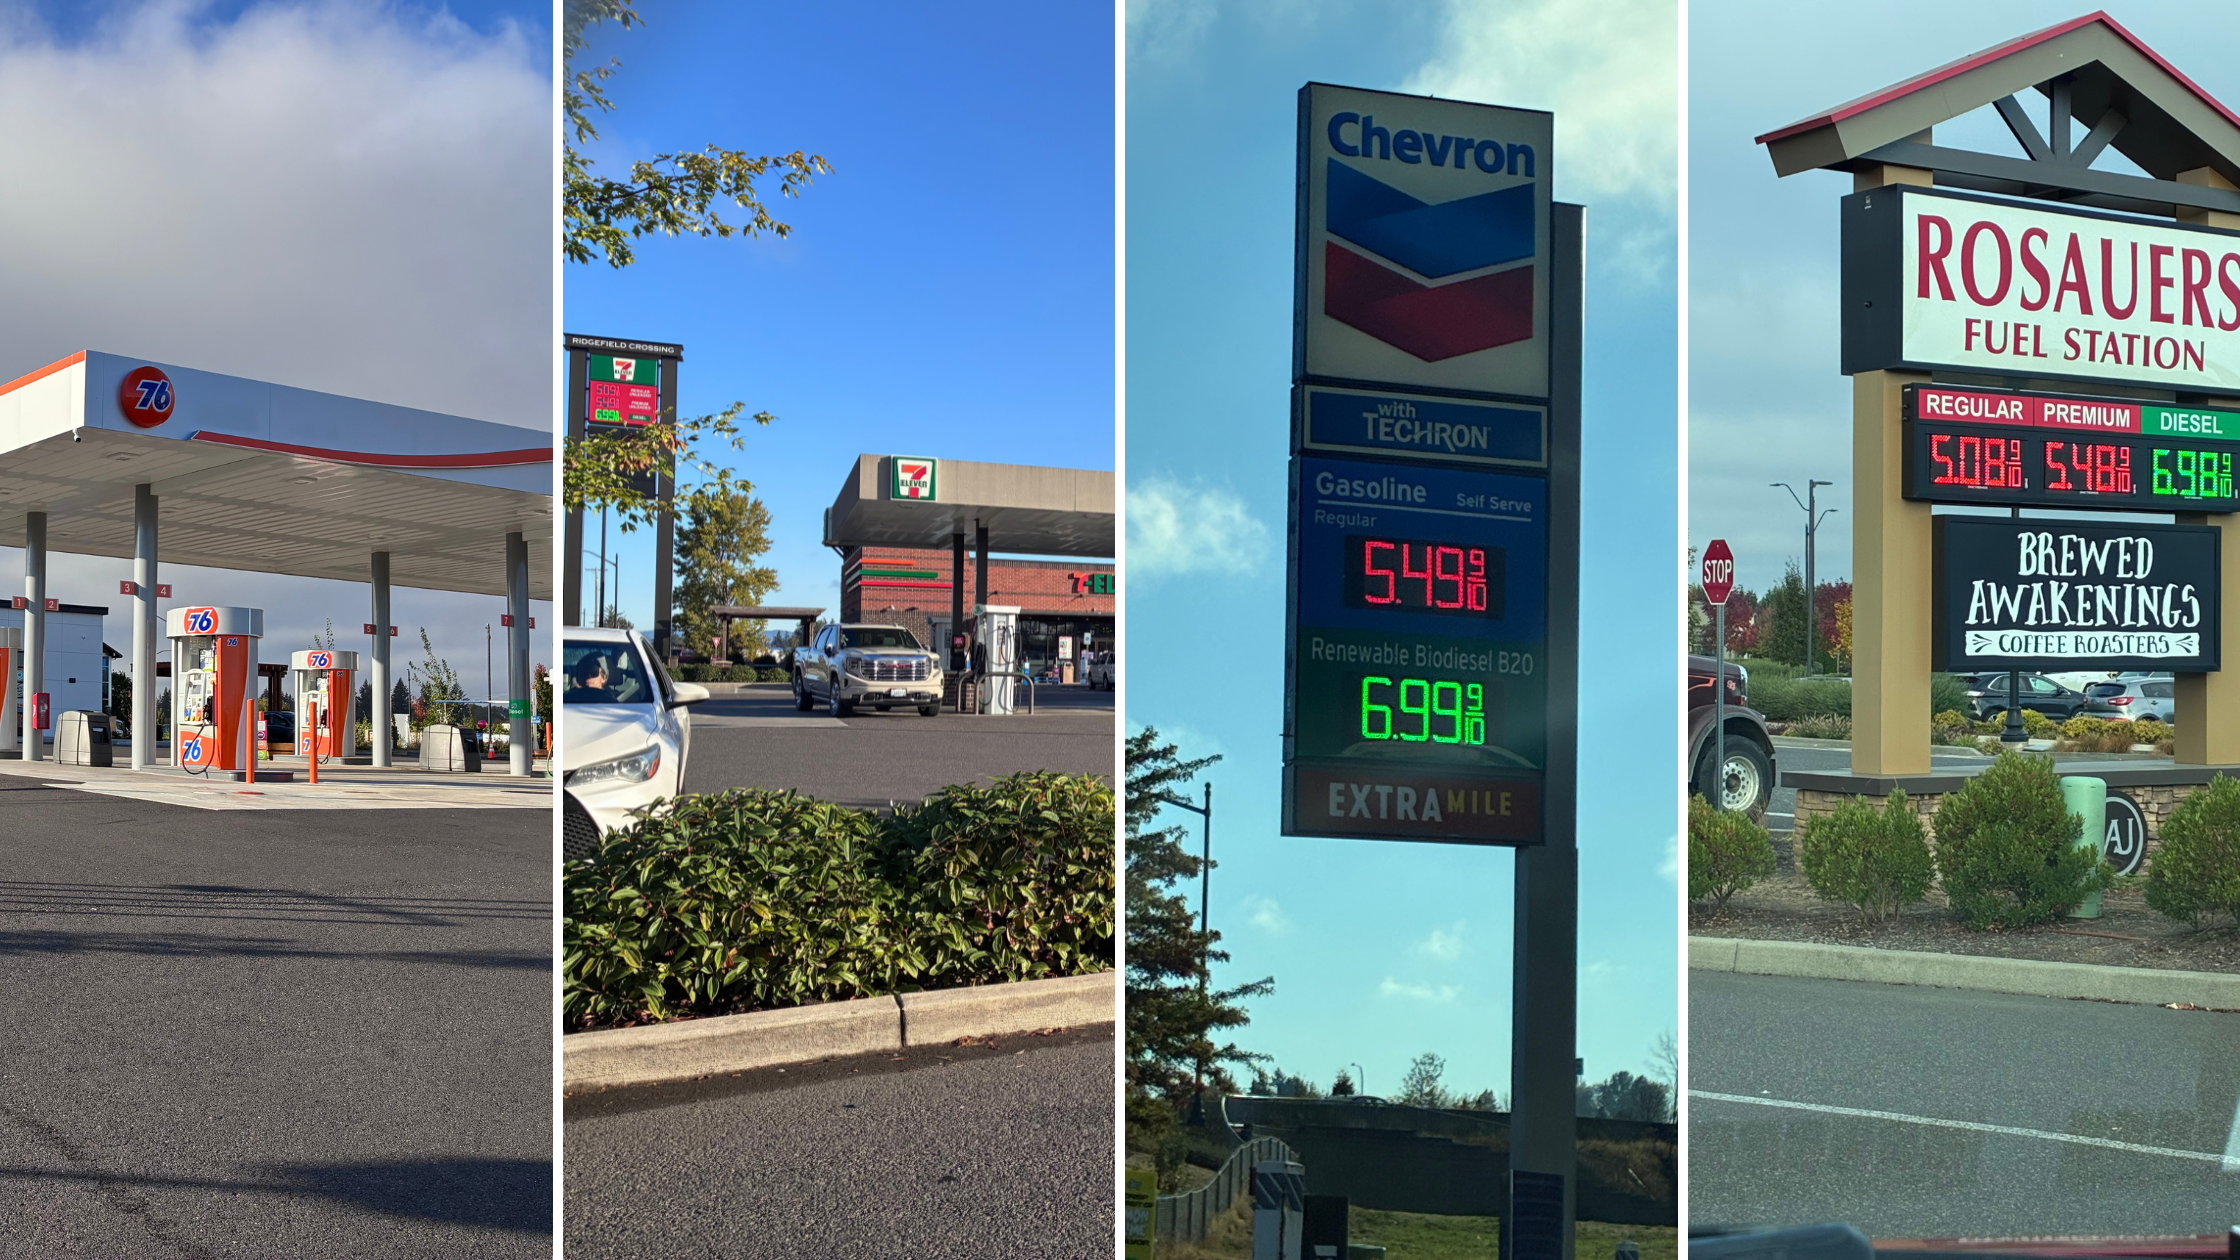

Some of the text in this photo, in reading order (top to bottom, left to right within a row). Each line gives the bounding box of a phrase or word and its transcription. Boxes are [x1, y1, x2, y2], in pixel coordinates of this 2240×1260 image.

[1327, 111, 1535, 178] Chevron
[1917, 213, 2240, 332] ROSAUERS
[572, 337, 675, 354] RIDGEFIELD CROSSING
[1964, 318, 2205, 372] FUEL STATION
[615, 360, 632, 381] 7
[135, 379, 171, 412] 76
[1926, 393, 2024, 420] REGULAR
[1377, 401, 1417, 419] with
[2043, 402, 2130, 428] PREMIUM
[1362, 412, 1488, 452] TECHRON
[2160, 412, 2223, 434] DIESEL
[1931, 434, 2006, 487] 5.08
[2046, 441, 2116, 492] 5.48
[2152, 448, 2219, 498] 6.98
[901, 463, 927, 498] 7
[1316, 471, 1428, 503] Gasoline
[1456, 493, 1533, 513] Self Serve
[1315, 510, 1377, 528] Regular
[2017, 531, 2154, 580] BREWED
[1365, 541, 1464, 609] 5.49
[1703, 559, 1733, 584] STOP
[124, 583, 130, 593] 3
[160, 586, 167, 596] 4
[48, 601, 54, 609] 2
[1964, 579, 2201, 629] AWAKENINGS
[188, 609, 214, 633] 76
[367, 625, 371, 633] 5
[390, 627, 395, 635] 6
[504, 616, 509, 625] 7
[227, 638, 238, 646] 76
[1998, 633, 2171, 654] COFFEE ROASTERS
[310, 652, 329, 667] 76
[1311, 637, 1534, 676] Renewable Biodiesel B20
[1361, 676, 1463, 744] 6.99
[182, 737, 202, 762] 76
[303, 738, 310, 752] 7
